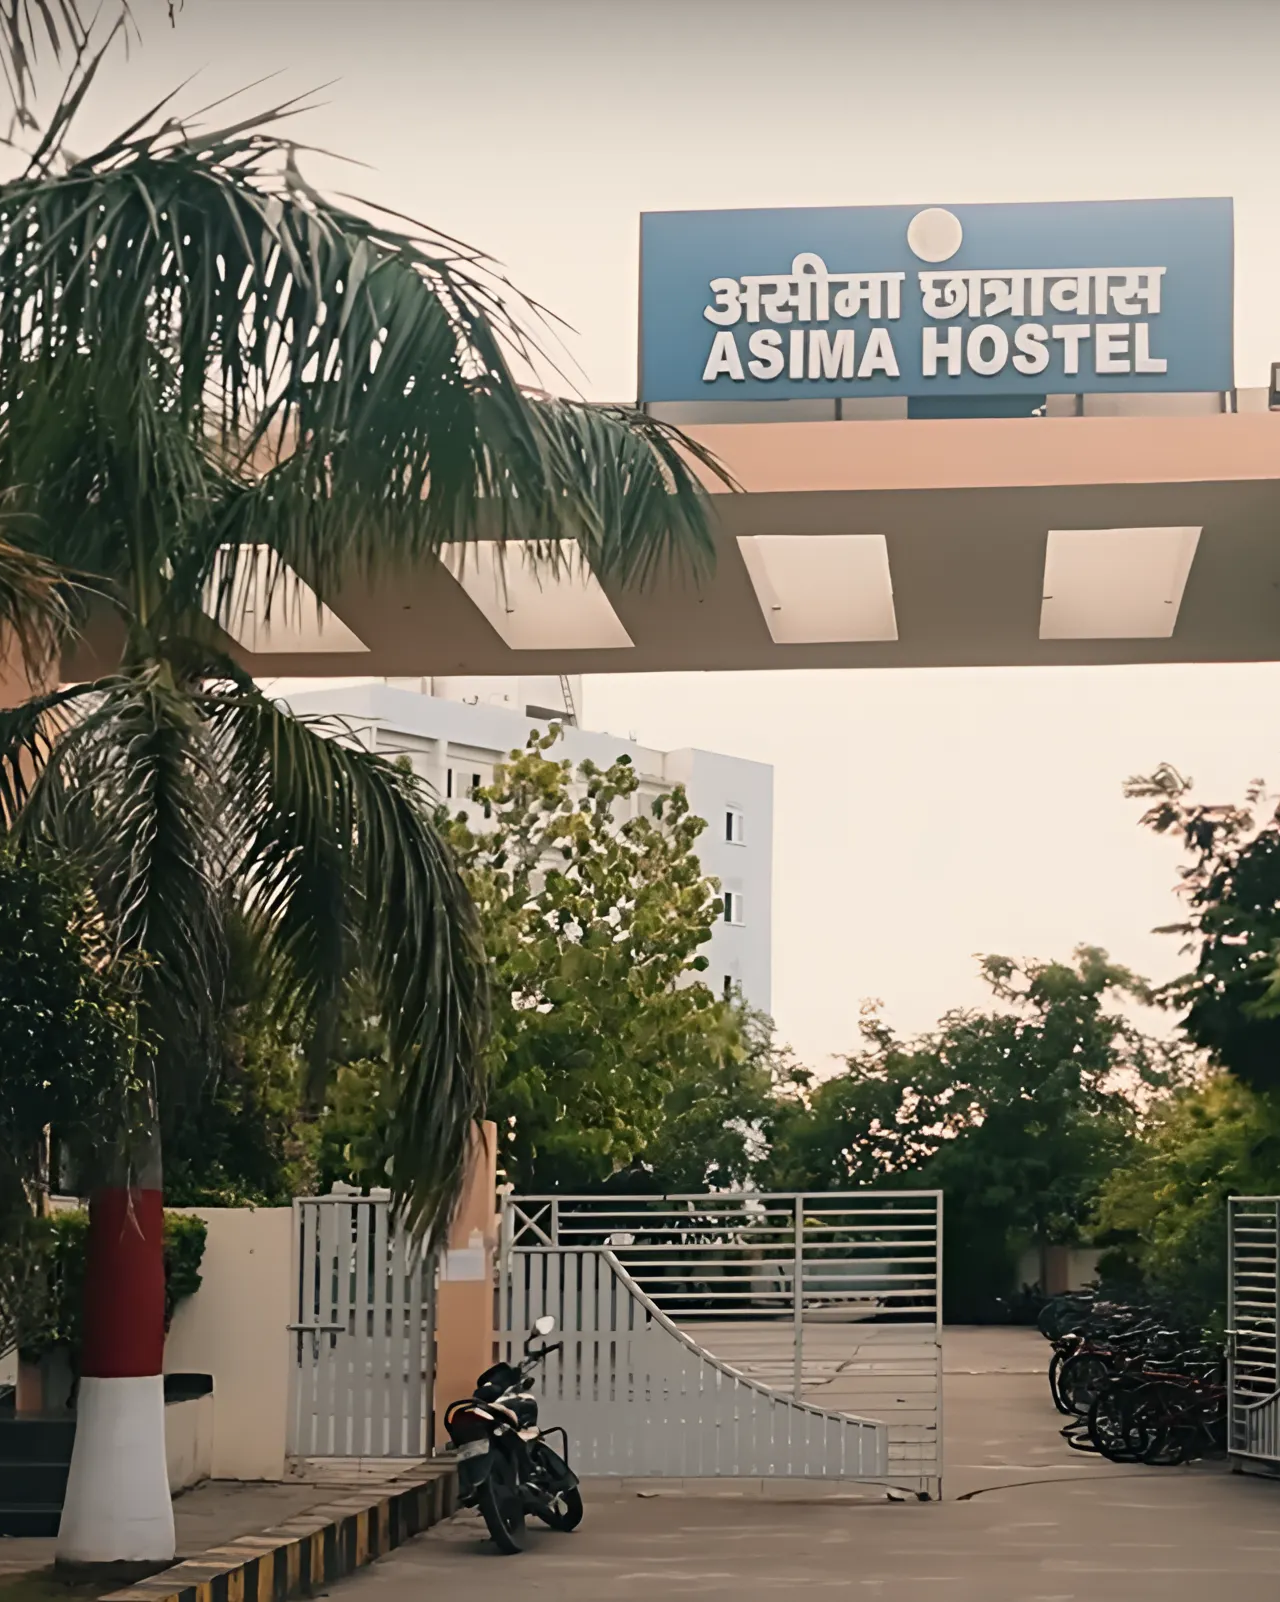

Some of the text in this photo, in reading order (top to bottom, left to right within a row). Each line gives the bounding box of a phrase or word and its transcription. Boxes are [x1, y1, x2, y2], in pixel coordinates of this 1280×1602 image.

[702, 252, 1167, 326] असीमा छात्रावास
[702, 322, 1168, 382] ASIMA HOSTEL
